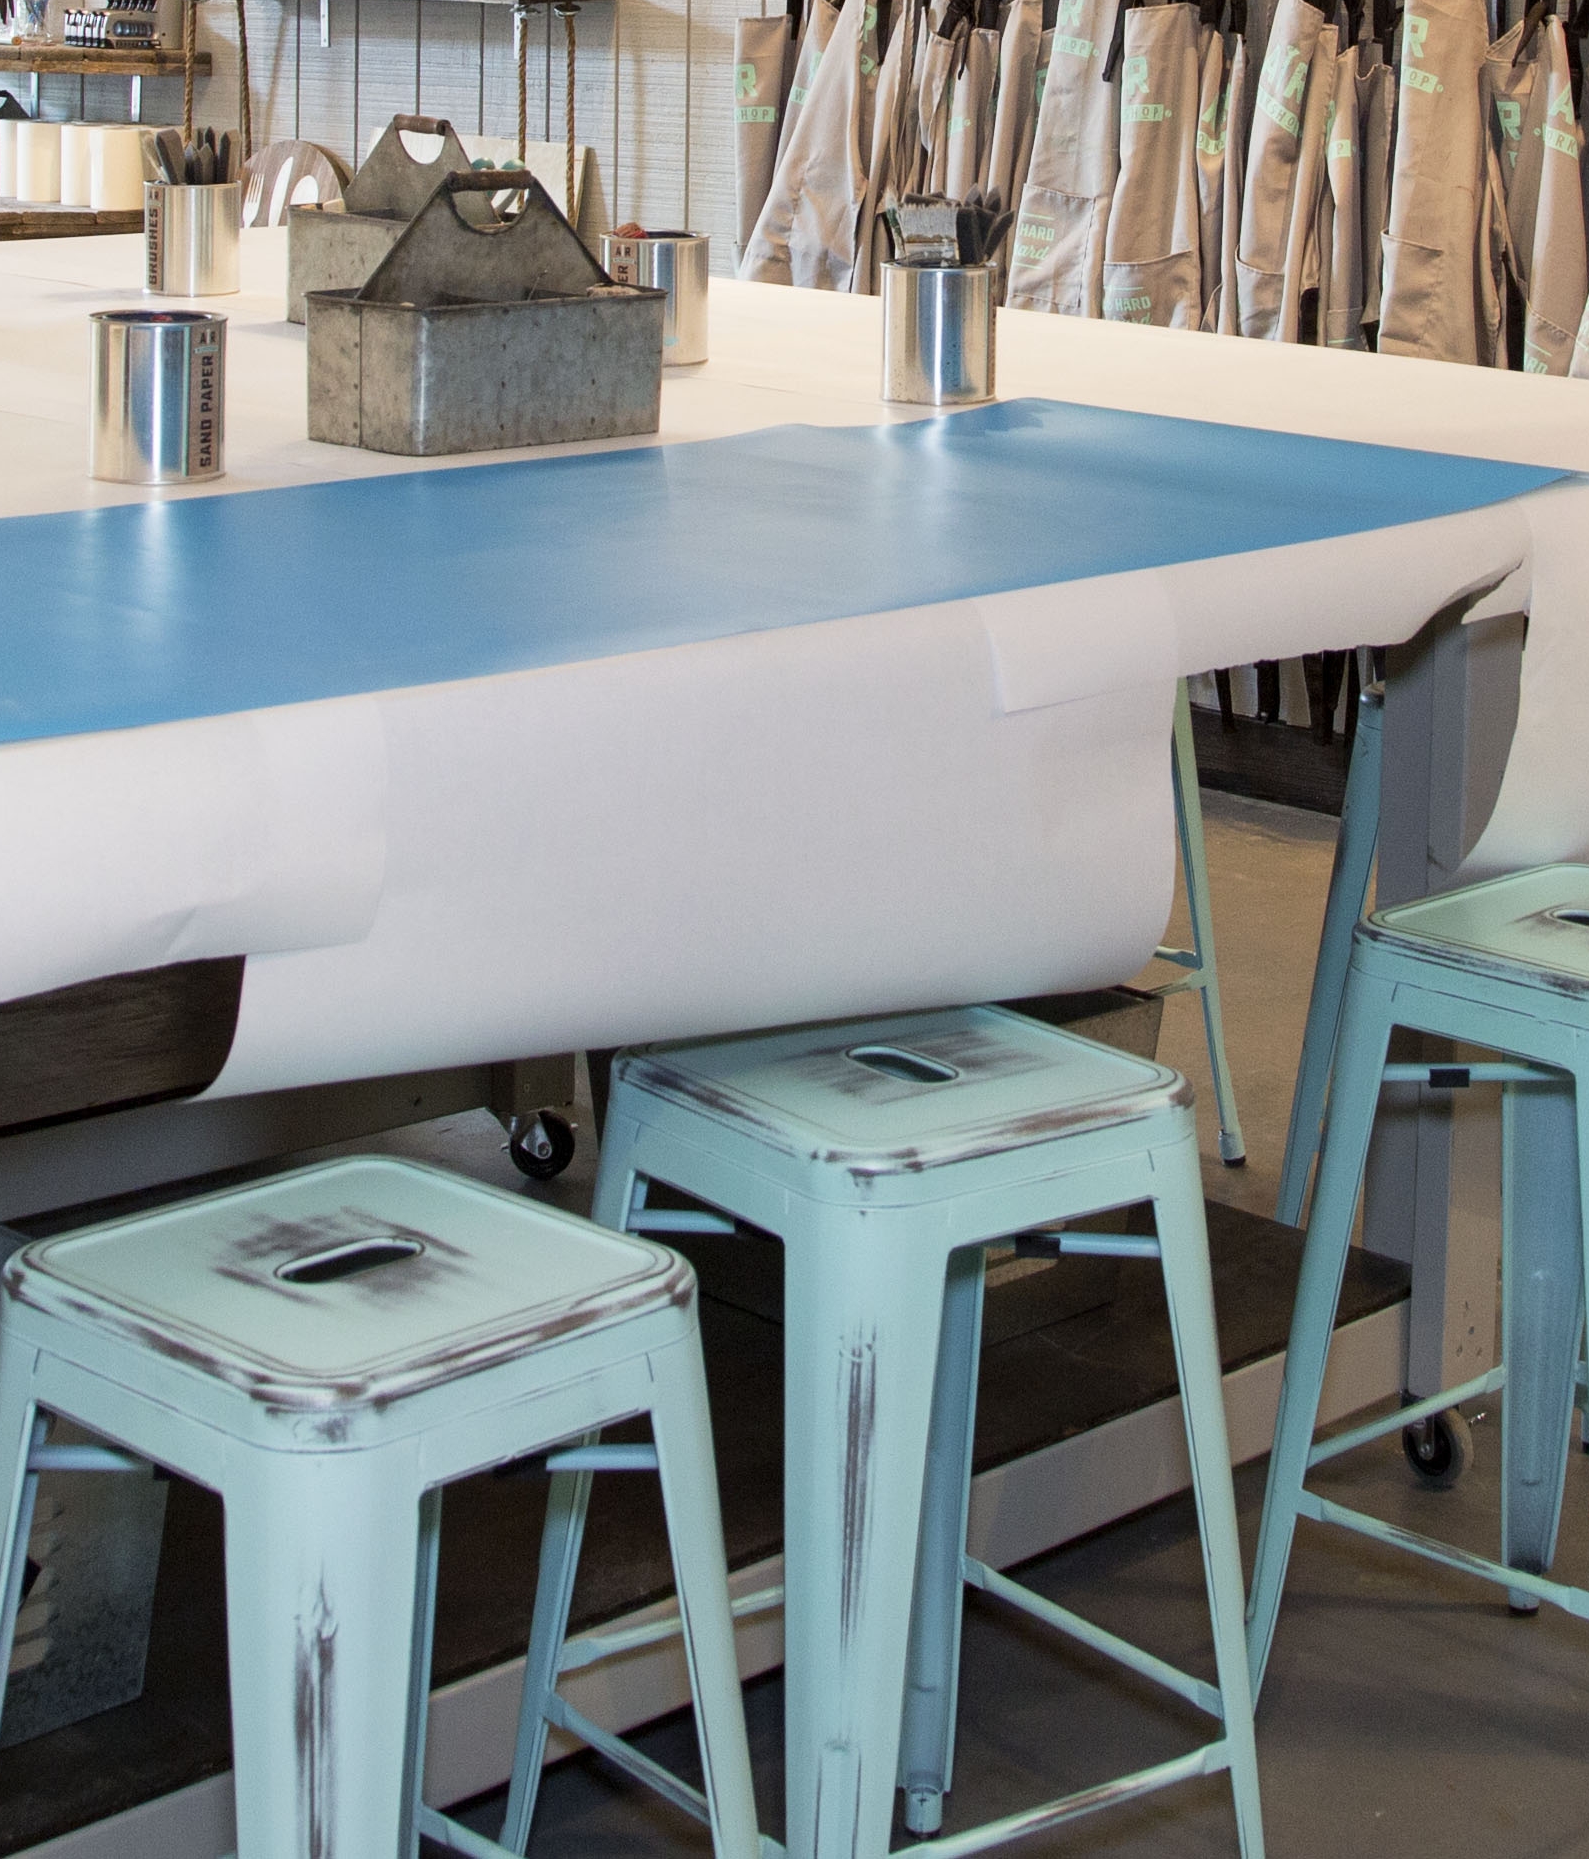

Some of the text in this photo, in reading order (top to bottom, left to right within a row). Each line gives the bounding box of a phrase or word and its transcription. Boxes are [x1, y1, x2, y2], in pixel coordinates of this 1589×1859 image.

[148, 207, 159, 286] BRUSHES
[1019, 223, 1056, 241] HARD
[199, 355, 214, 468] SAND PAPER
